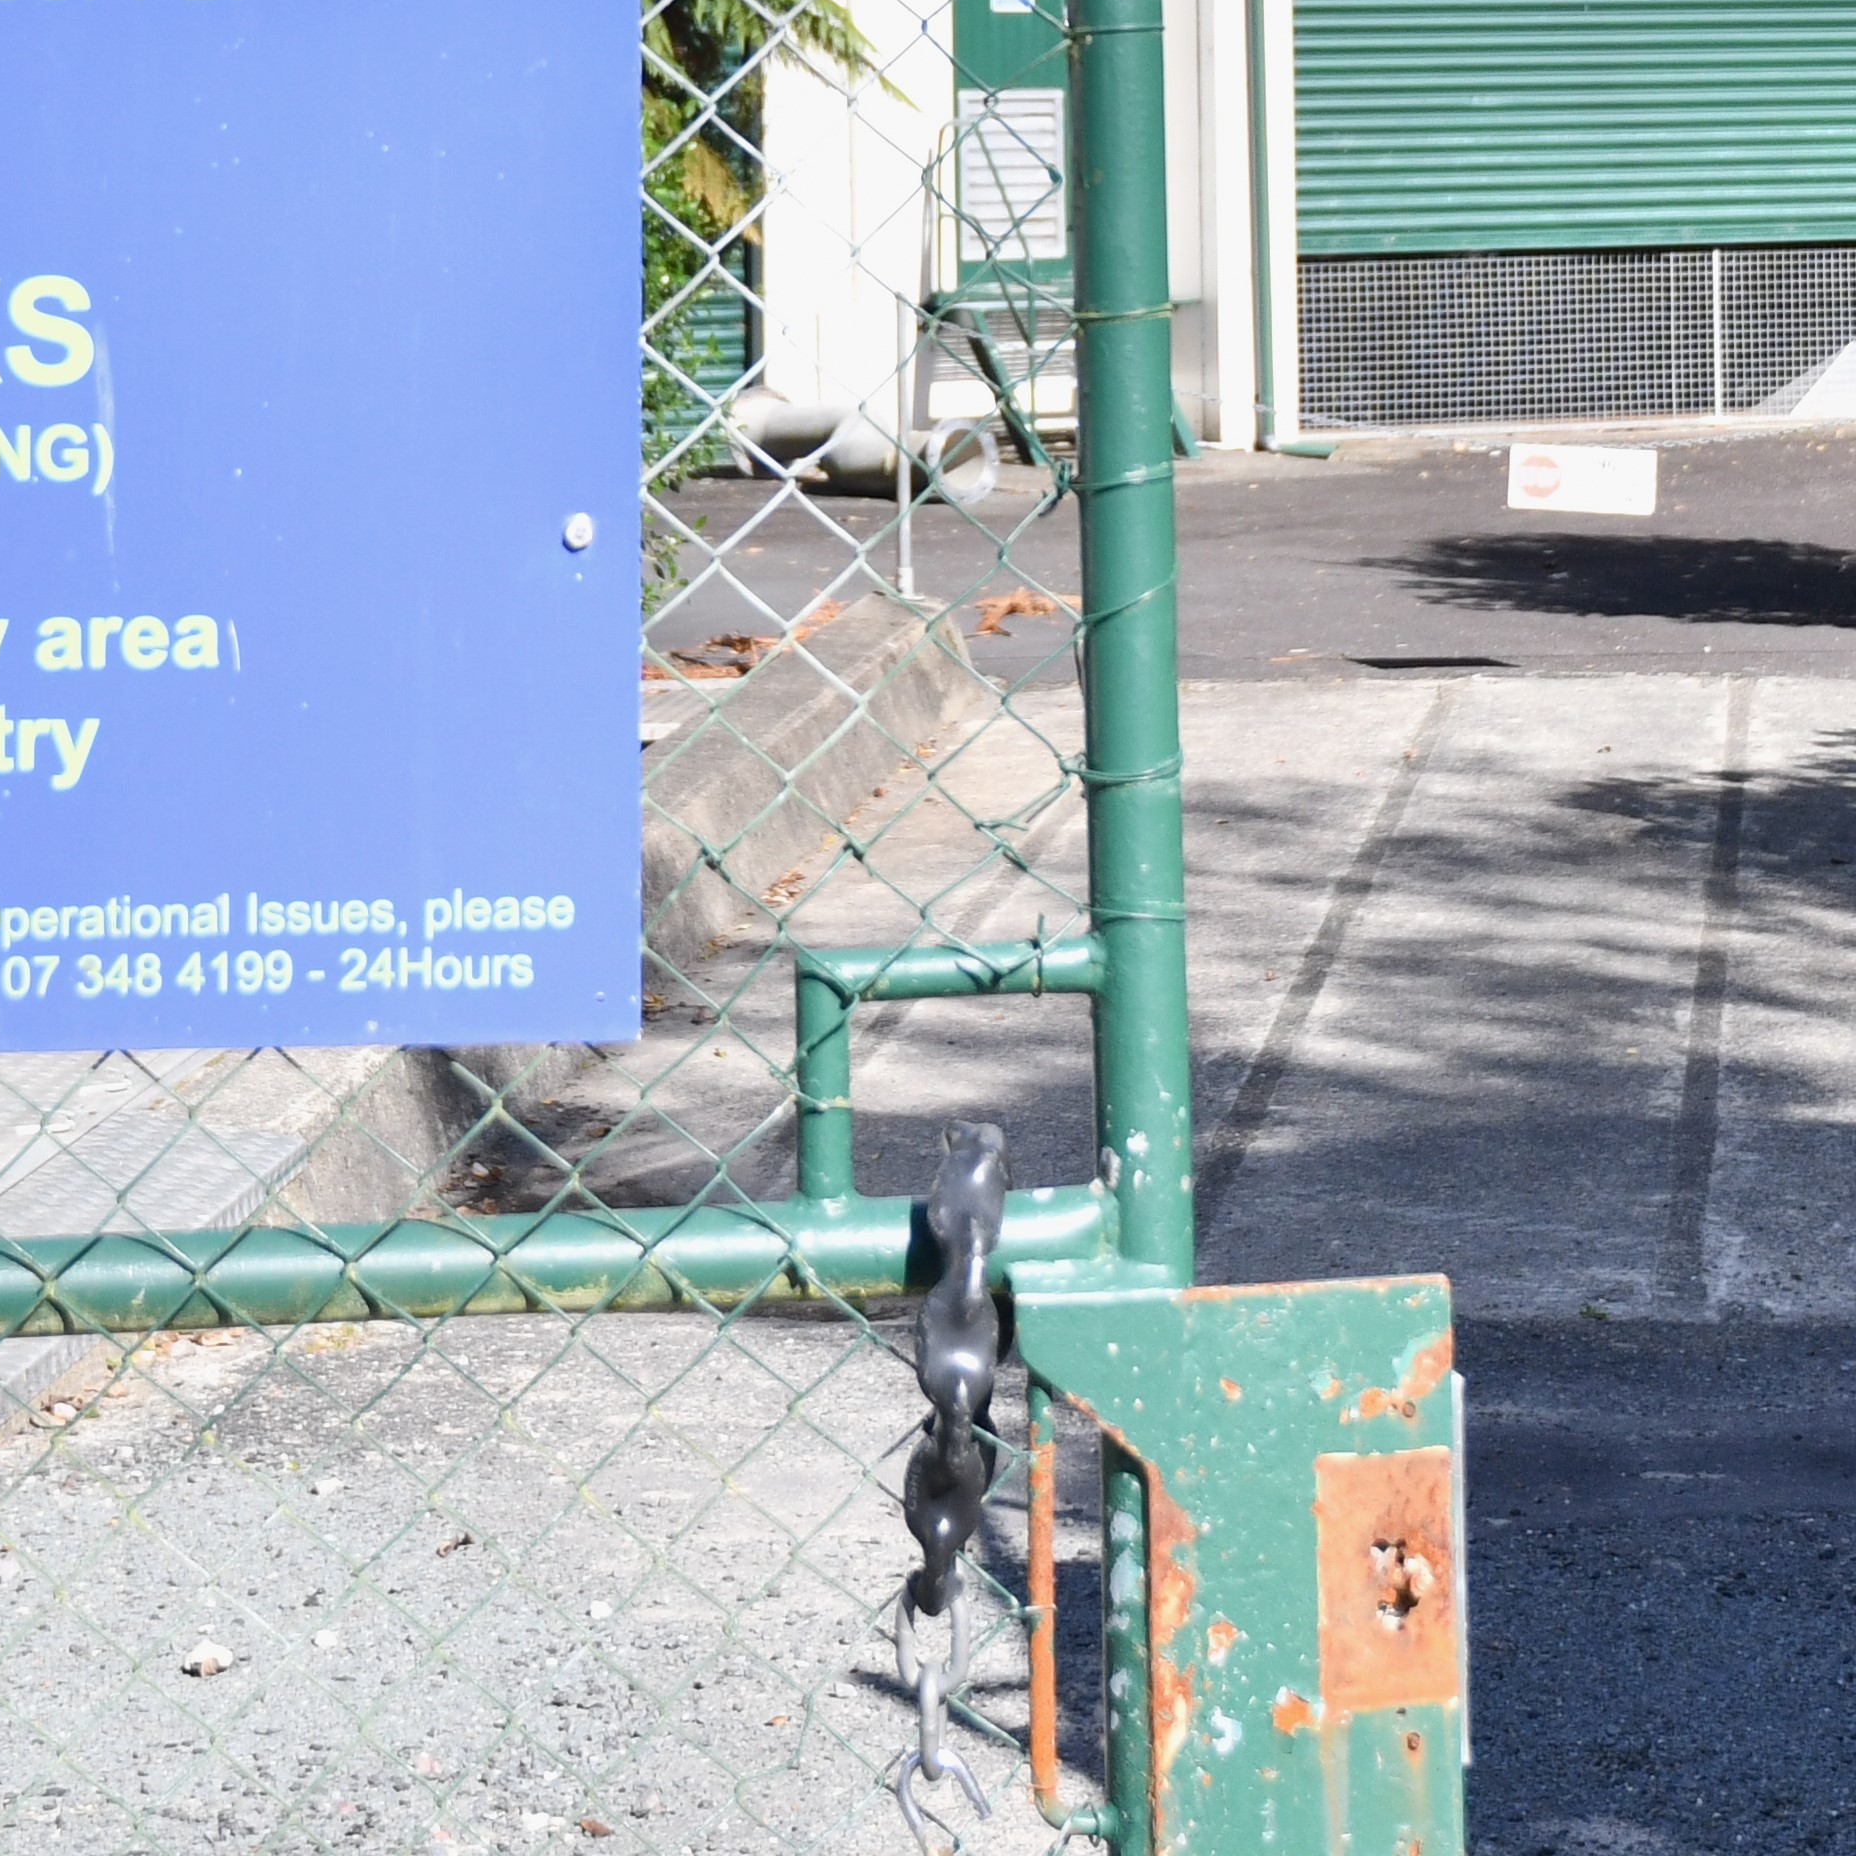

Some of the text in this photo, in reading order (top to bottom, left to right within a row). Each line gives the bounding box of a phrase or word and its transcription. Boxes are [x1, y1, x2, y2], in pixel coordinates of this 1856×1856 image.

[36, 614, 220, 671] area
[247, 892, 407, 937] Issues,
[425, 887, 575, 941] please
[1, 955, 60, 999] 07
[77, 952, 163, 997] 348
[176, 949, 293, 994] 4199
[339, 946, 534, 991] 24Hours
